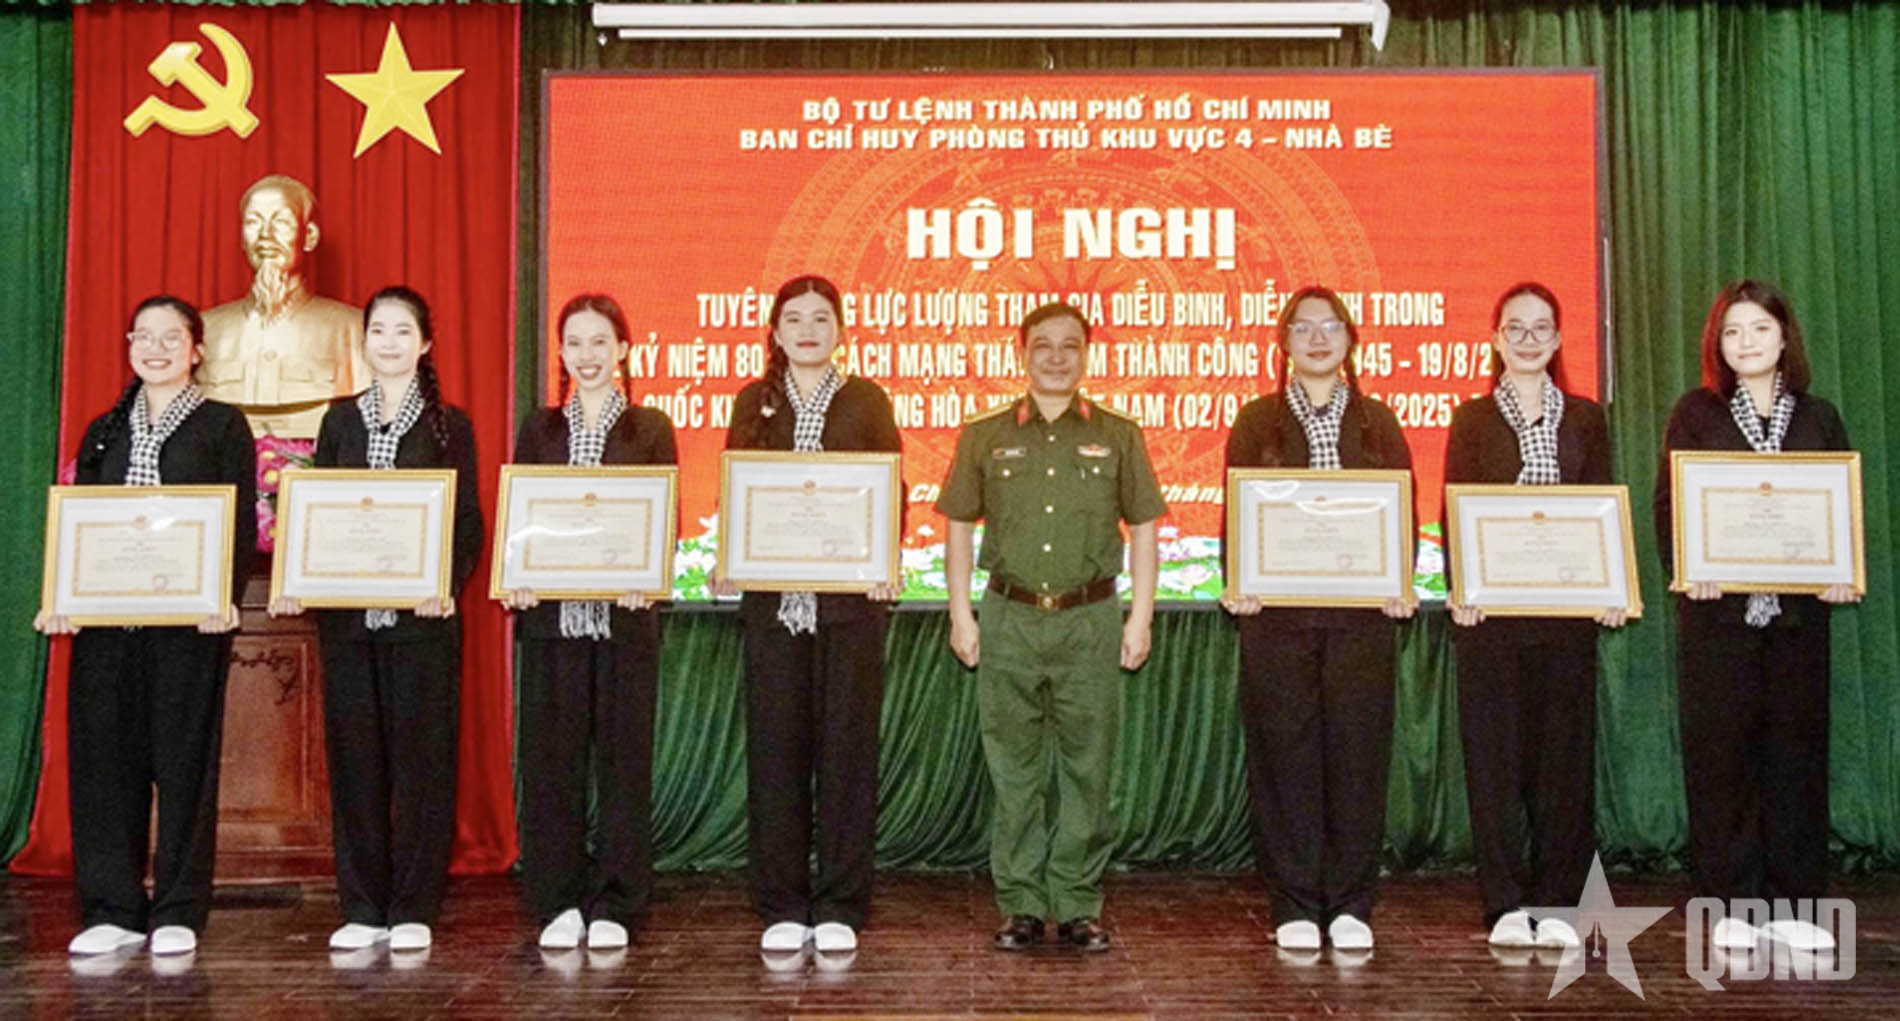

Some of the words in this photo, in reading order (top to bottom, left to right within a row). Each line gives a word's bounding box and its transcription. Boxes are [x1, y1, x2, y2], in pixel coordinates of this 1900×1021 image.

[803, 96, 840, 125] BỘ
[852, 97, 892, 121] TƯ
[898, 96, 973, 125] LỆNH
[983, 95, 1078, 121] THÀNH
[1087, 94, 1145, 121] PHỐ
[1203, 95, 1249, 121] CHÍ
[1257, 98, 1331, 121] MINH
[739, 127, 799, 150] BAN
[807, 122, 853, 150] CHỈ
[861, 127, 919, 150] HUY
[929, 124, 1026, 150] PHÒNG
[1036, 121, 1091, 150] THỦ
[1100, 127, 1158, 149] KHU
[1167, 125, 1226, 153] VỰC
[1234, 127, 1254, 149] 4
[1284, 123, 1344, 149] NHÀ
[1354, 123, 1393, 149] BÈ
[906, 196, 1034, 271] HỘI
[1062, 206, 1236, 271] NGHỊ
[862, 287, 907, 335] LỰC
[913, 287, 989, 335] LƯỢNG
[1111, 279, 1167, 327] DIỄU
[1172, 291, 1234, 332] BINH,
[1369, 291, 1446, 327] TRONG
[629, 331, 660, 379] KỶ
[667, 336, 729, 386] NIỆM
[735, 342, 765, 379] 80
[831, 335, 892, 379] CÁCH
[898, 342, 967, 386] MẠNG
[973, 335, 1026, 378] THÁ
[1115, 334, 1191, 378] THÀNH
[1196, 336, 1259, 378] CÔNG
[1417, 341, 1493, 381] 19/8/2
[930, 384, 978, 429] HÒA
